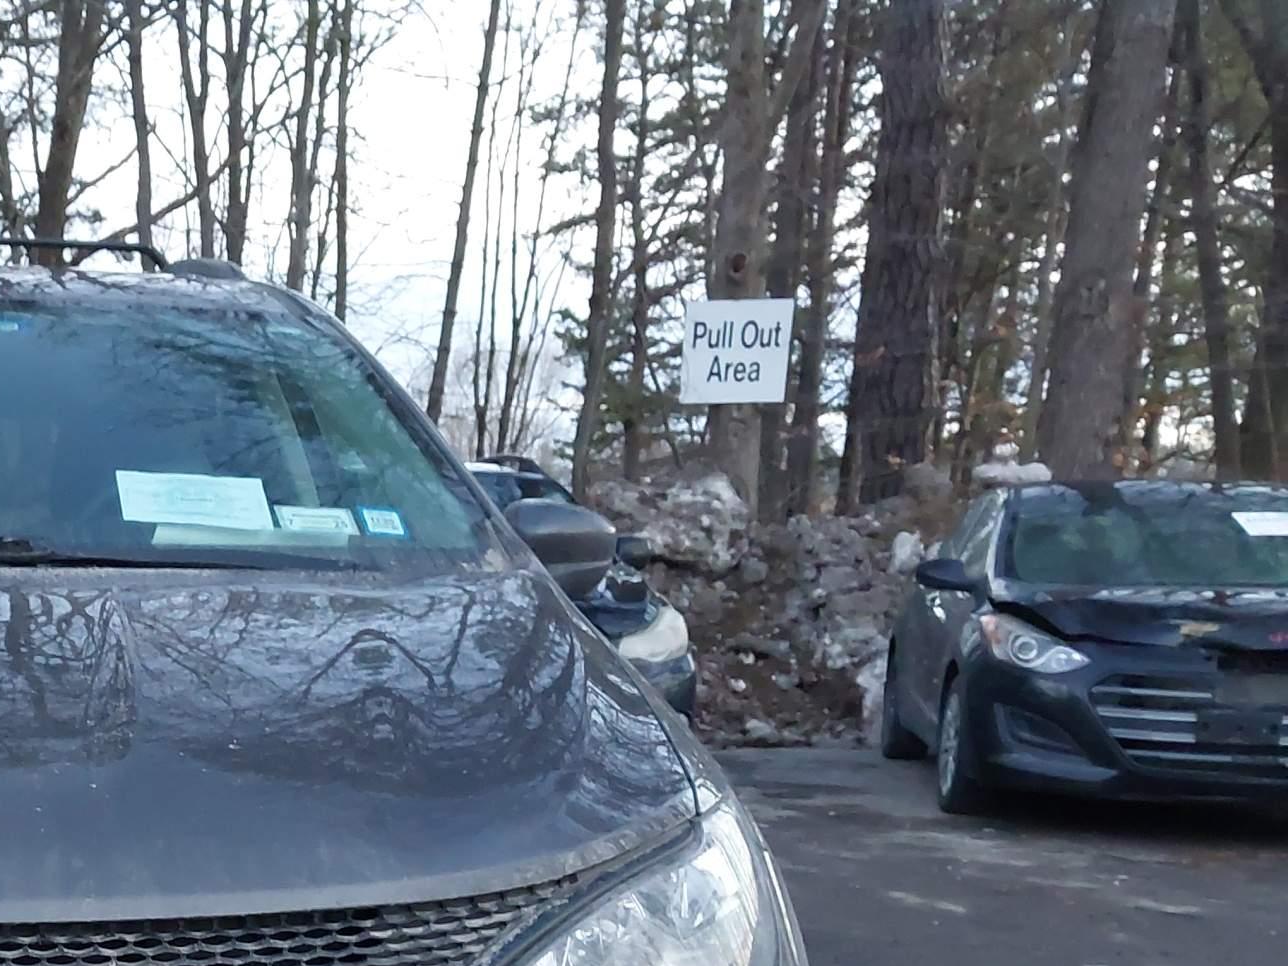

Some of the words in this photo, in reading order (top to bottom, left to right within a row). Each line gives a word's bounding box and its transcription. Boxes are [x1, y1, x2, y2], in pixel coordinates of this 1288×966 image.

[692, 320, 734, 349] Pull
[741, 320, 781, 349] Out
[706, 355, 761, 383] Area
